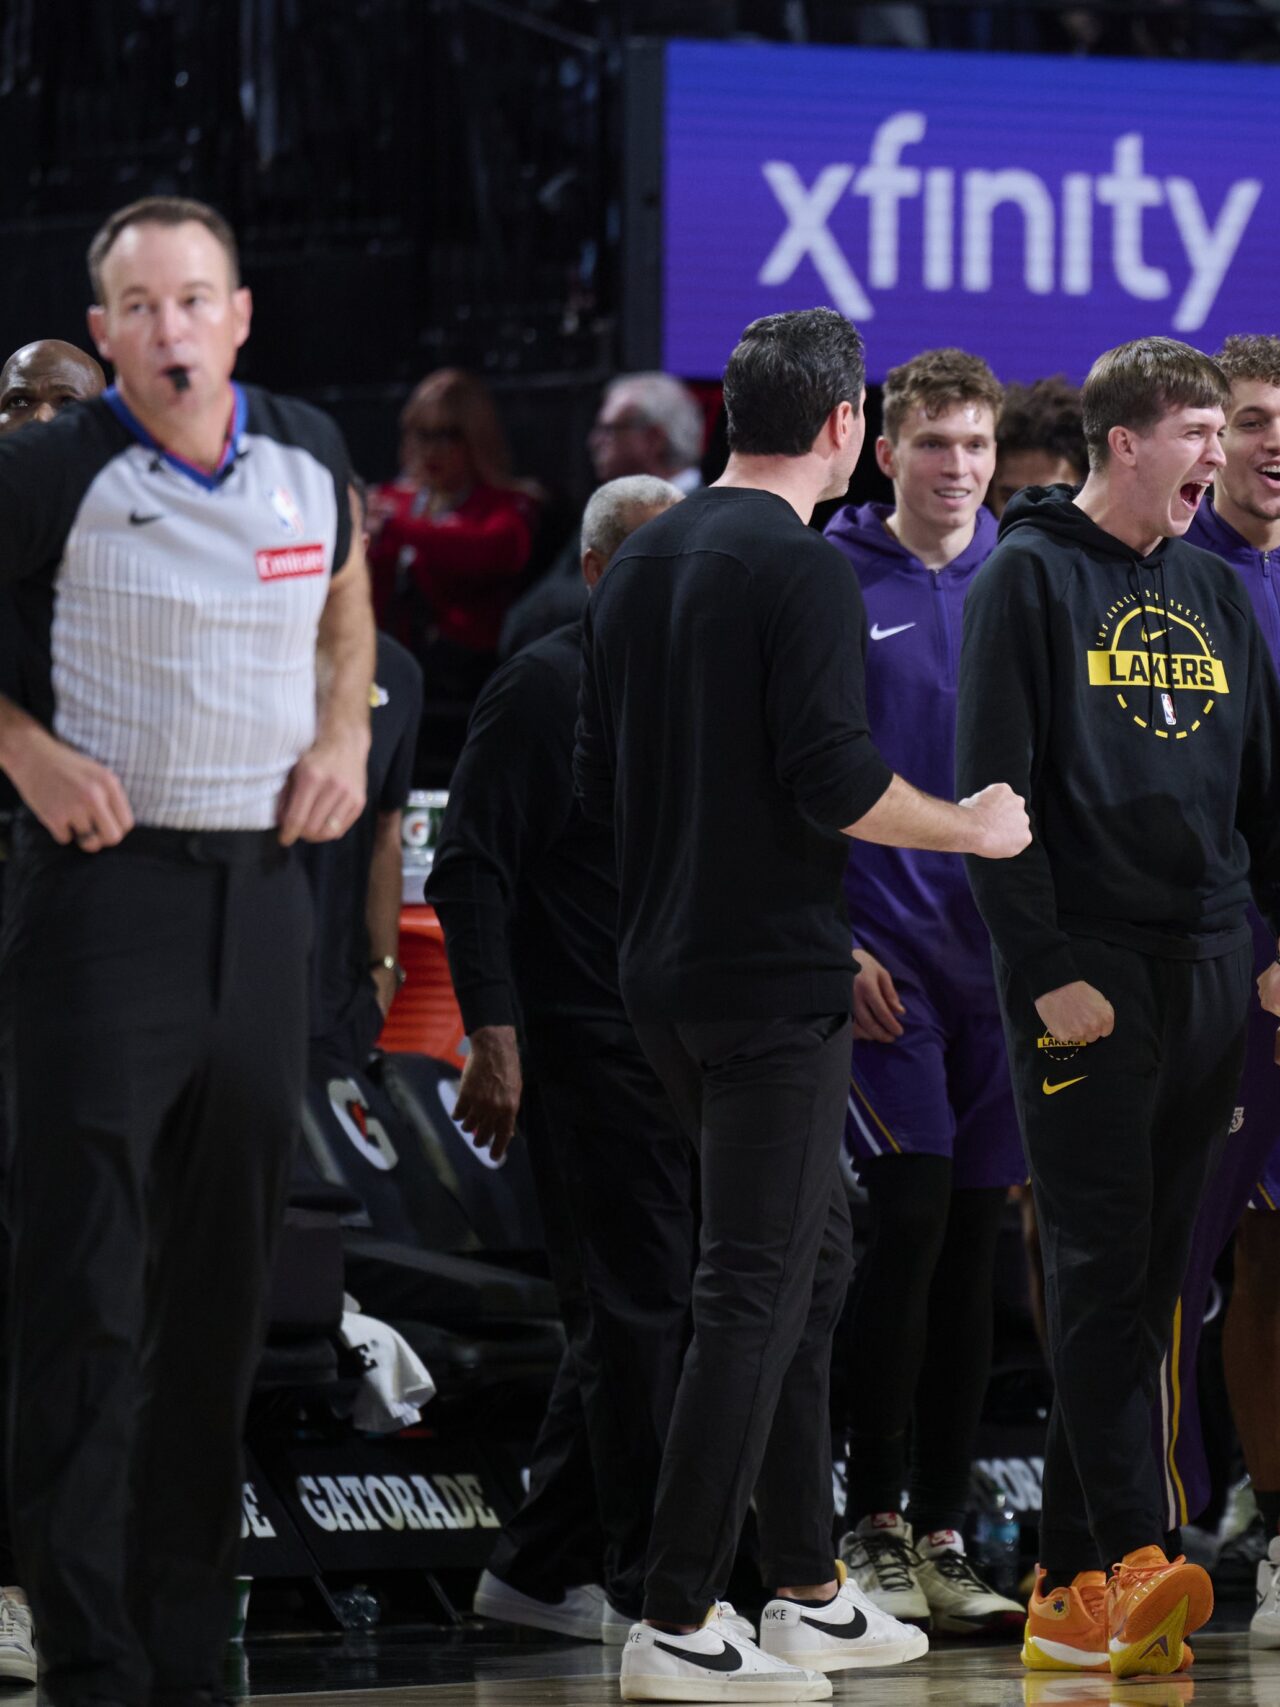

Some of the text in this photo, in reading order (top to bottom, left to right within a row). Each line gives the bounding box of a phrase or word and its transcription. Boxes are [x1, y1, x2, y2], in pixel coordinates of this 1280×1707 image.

[759, 111, 1262, 332] xfinity
[1106, 589, 1151, 620] ANGELS
[1108, 653, 1216, 687] LAKERS
[299, 1474, 501, 1531] GATORADE
[764, 1609, 787, 1621] NIKE
